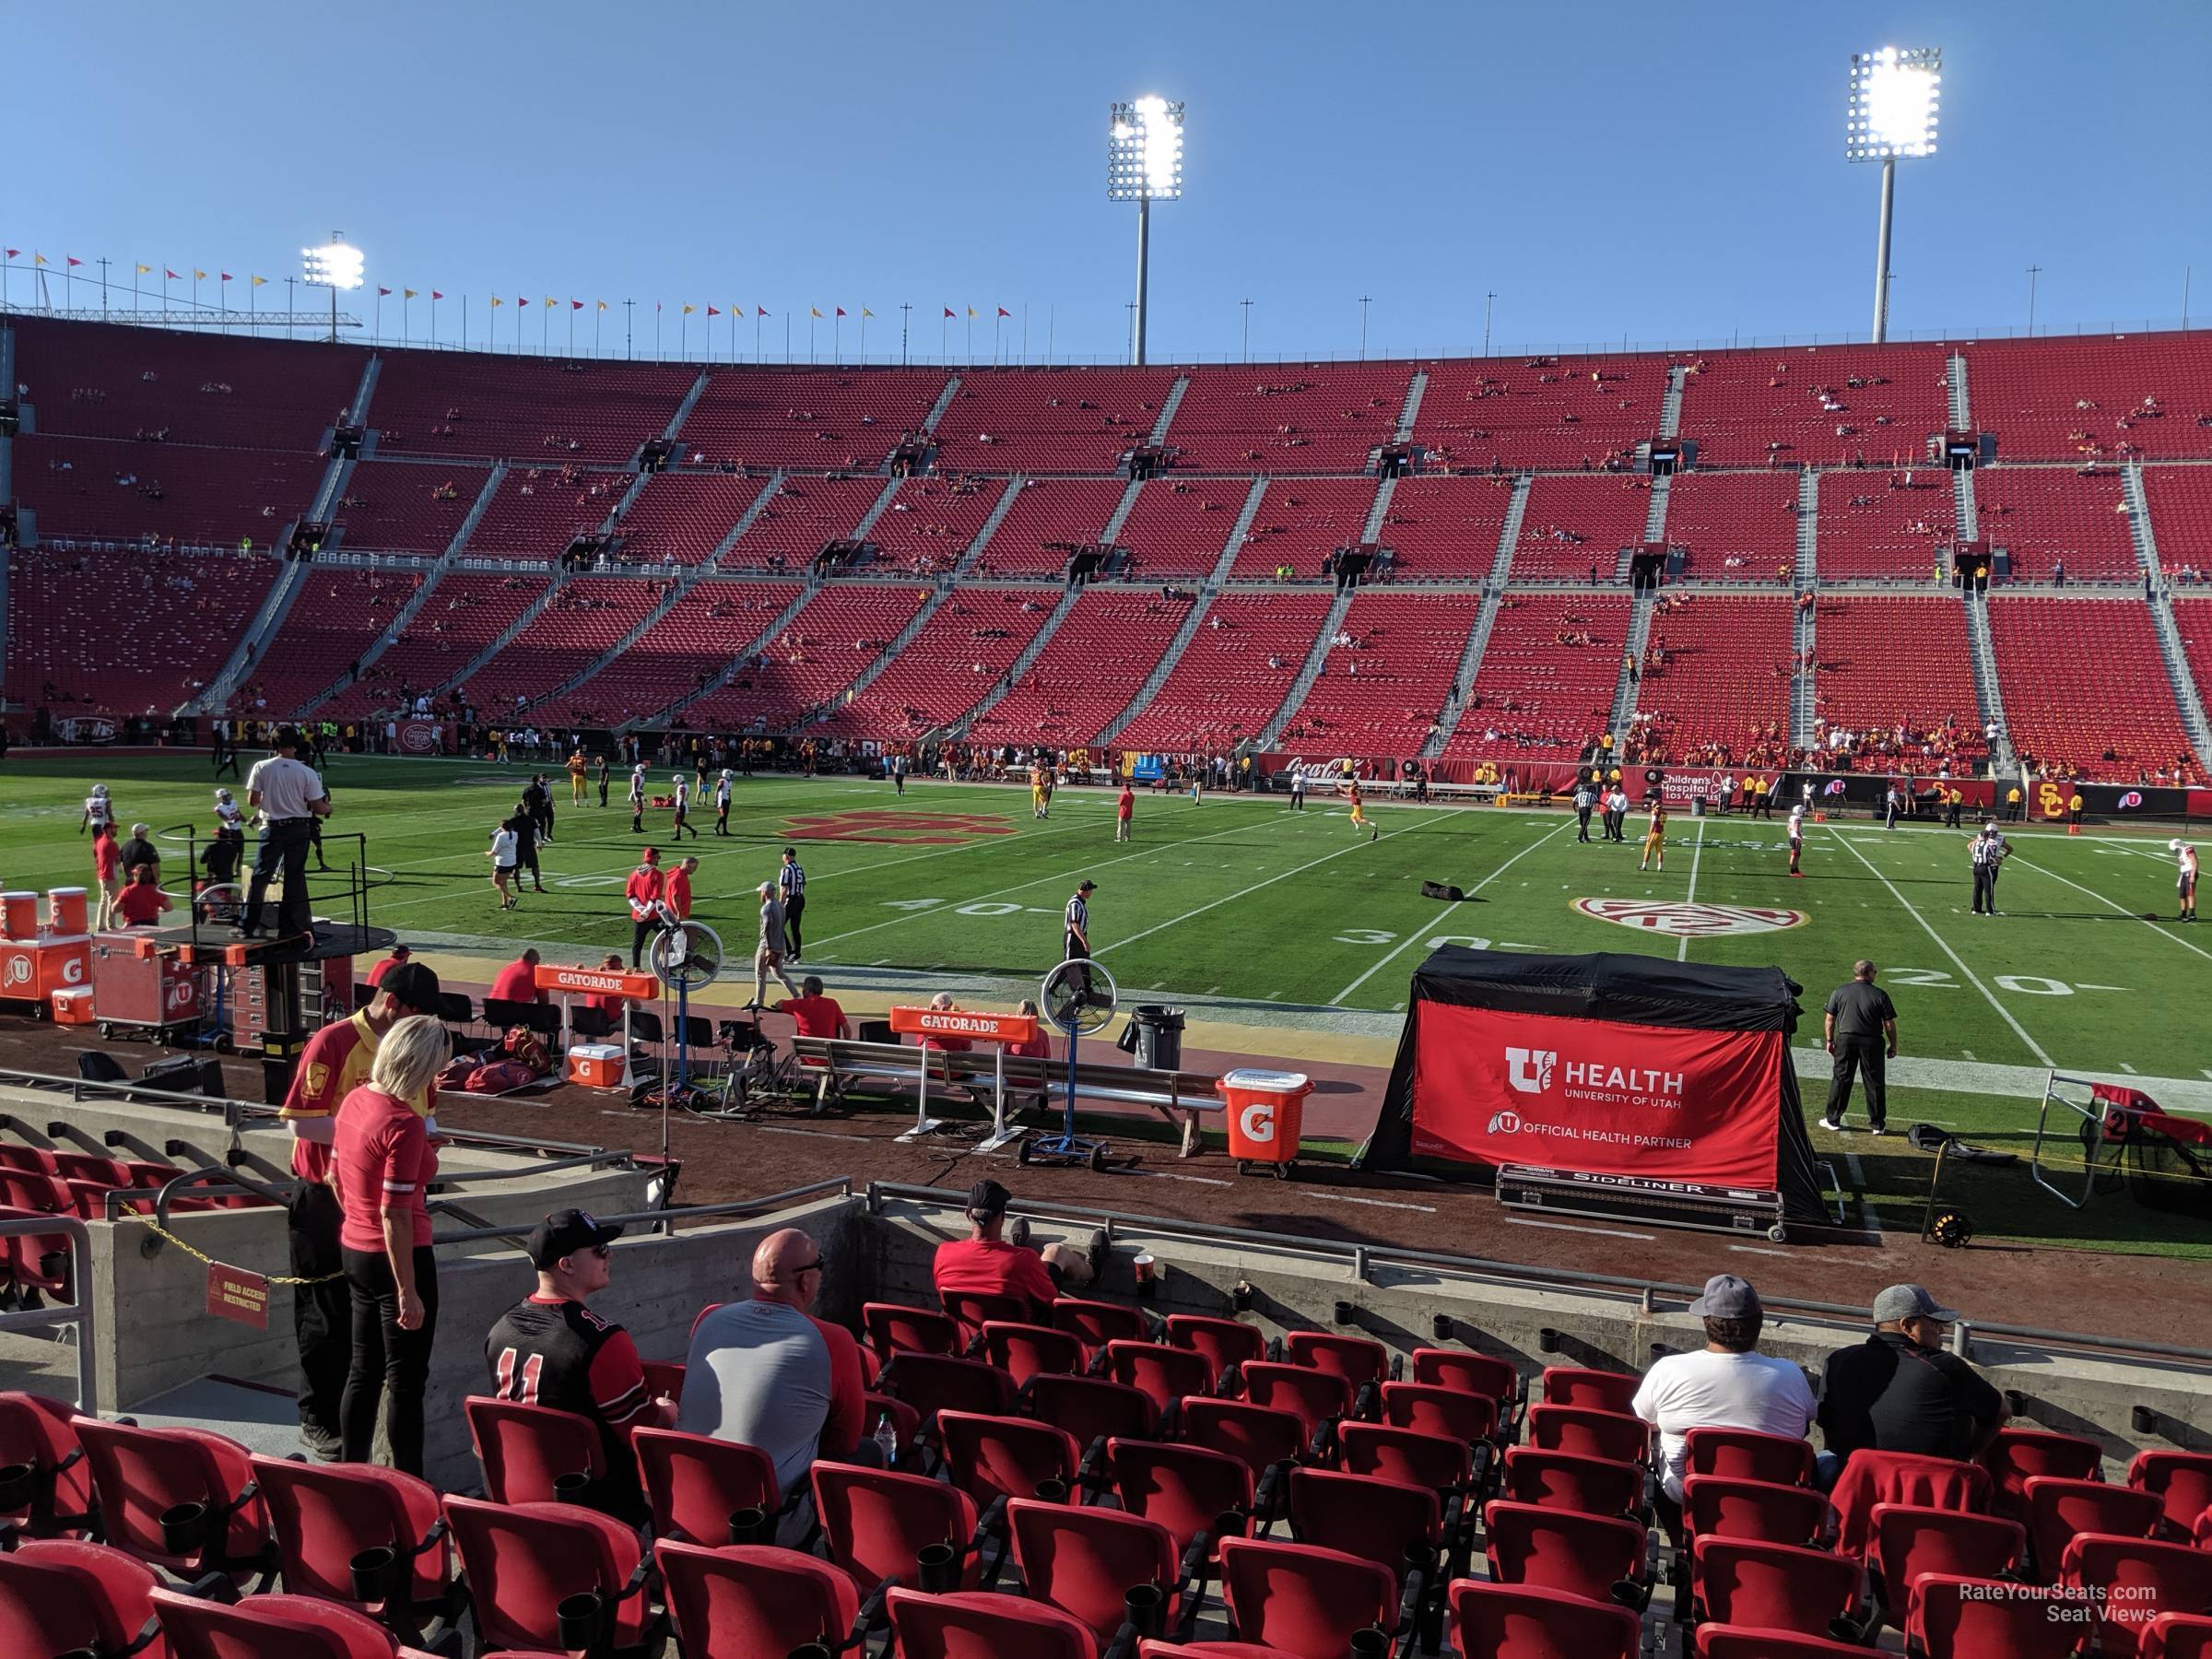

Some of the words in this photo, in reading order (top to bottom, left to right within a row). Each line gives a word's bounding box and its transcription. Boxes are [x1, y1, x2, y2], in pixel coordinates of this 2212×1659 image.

[1285, 756, 1364, 781] Coca-Coa
[1662, 783, 1708, 795] Hospital
[1663, 775, 1712, 785] Children's
[64, 958, 82, 983] G
[558, 972, 623, 991] GATORADE
[921, 1015, 998, 1033] GATORADE
[579, 1061, 591, 1077] G
[1565, 1061, 1684, 1095] HEALTH
[1565, 1088, 1630, 1105] UNIVERSITY
[1632, 1096, 1648, 1106] OF
[1651, 1099, 1681, 1110] UTAH
[1240, 1103, 1275, 1143] G
[1524, 1123, 1580, 1139] OFFICIAL
[1583, 1129, 1630, 1145] HEALTH
[1634, 1135, 1692, 1149] PARTNER
[1573, 1172, 1705, 1194] SIDELINER
[224, 1281, 241, 1294] FIELD
[242, 1287, 266, 1301] ACCESS
[224, 1293, 261, 1312] RESTRICTED
[497, 1347, 544, 1406] 11
